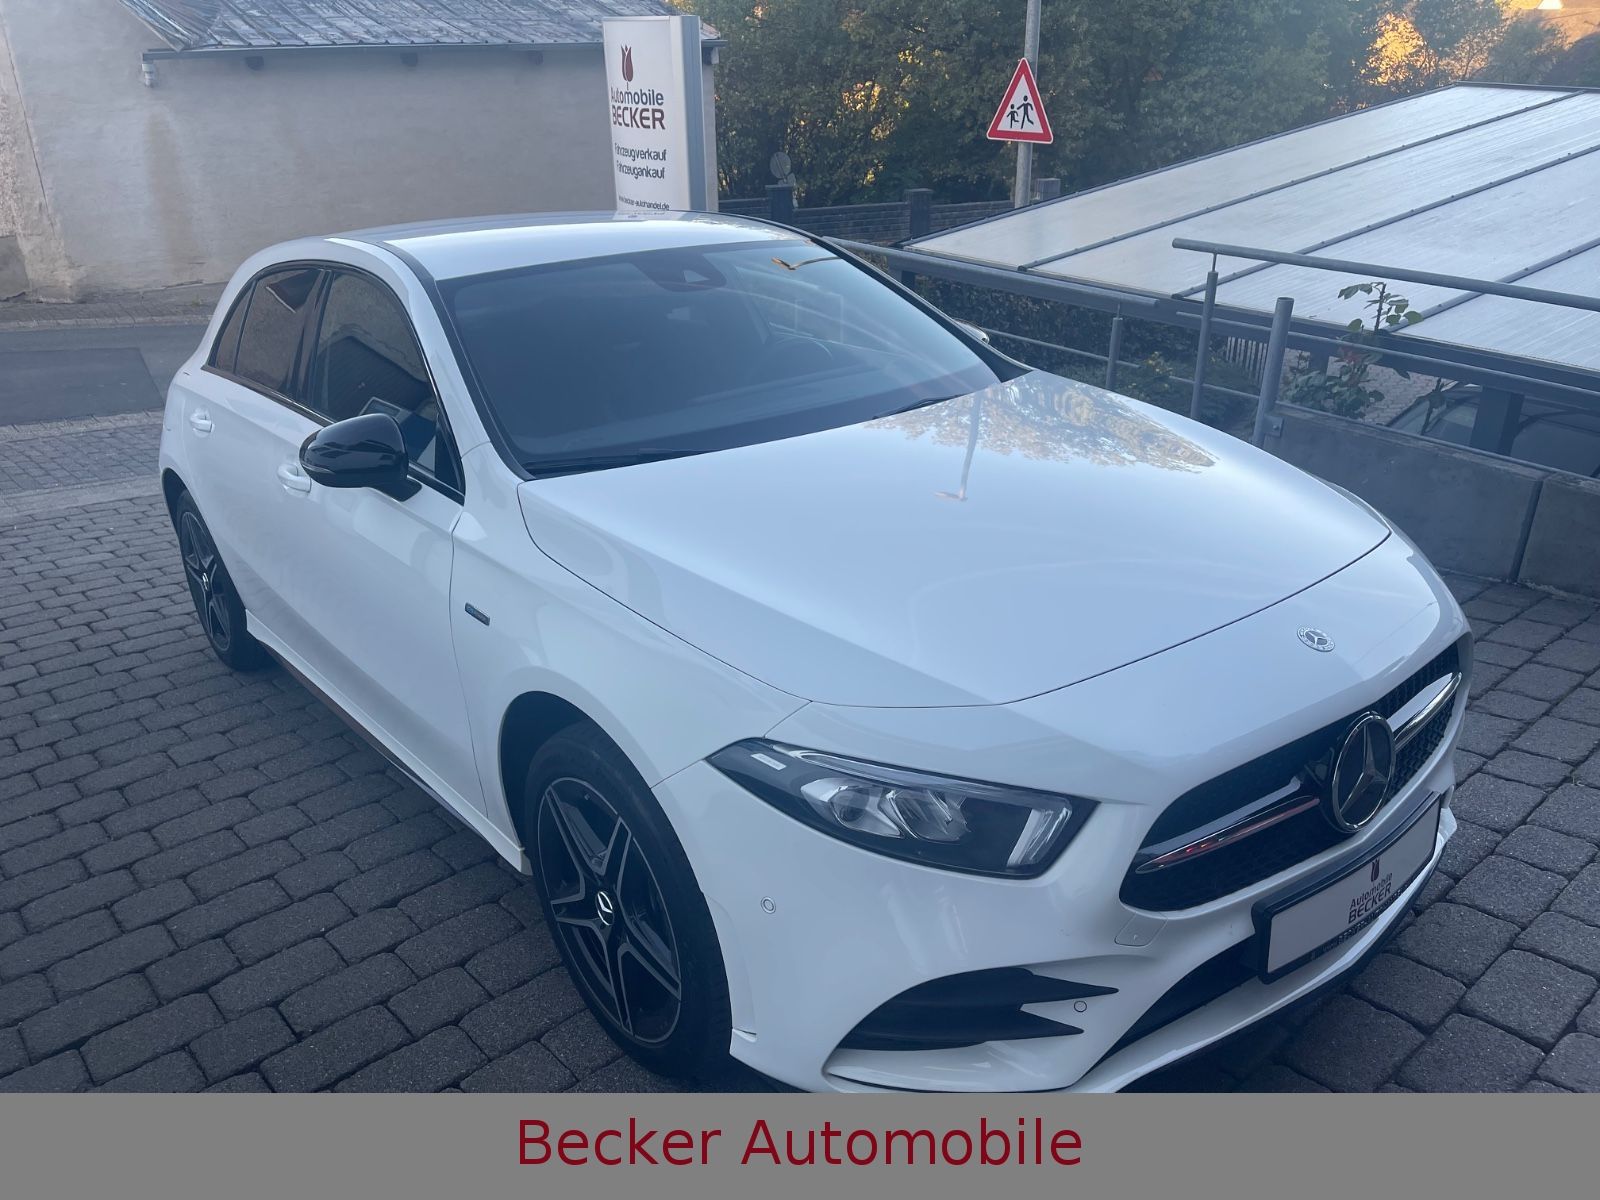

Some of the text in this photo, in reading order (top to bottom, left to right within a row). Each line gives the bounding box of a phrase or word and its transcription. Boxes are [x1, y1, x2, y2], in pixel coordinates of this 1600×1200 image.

[610, 86, 664, 106] Automobile
[612, 104, 666, 130] BECKER
[614, 142, 667, 162] Fhrzeugverkauf
[616, 160, 665, 180] Fhrzeugankauf
[1347, 882, 1392, 924] BECKER
